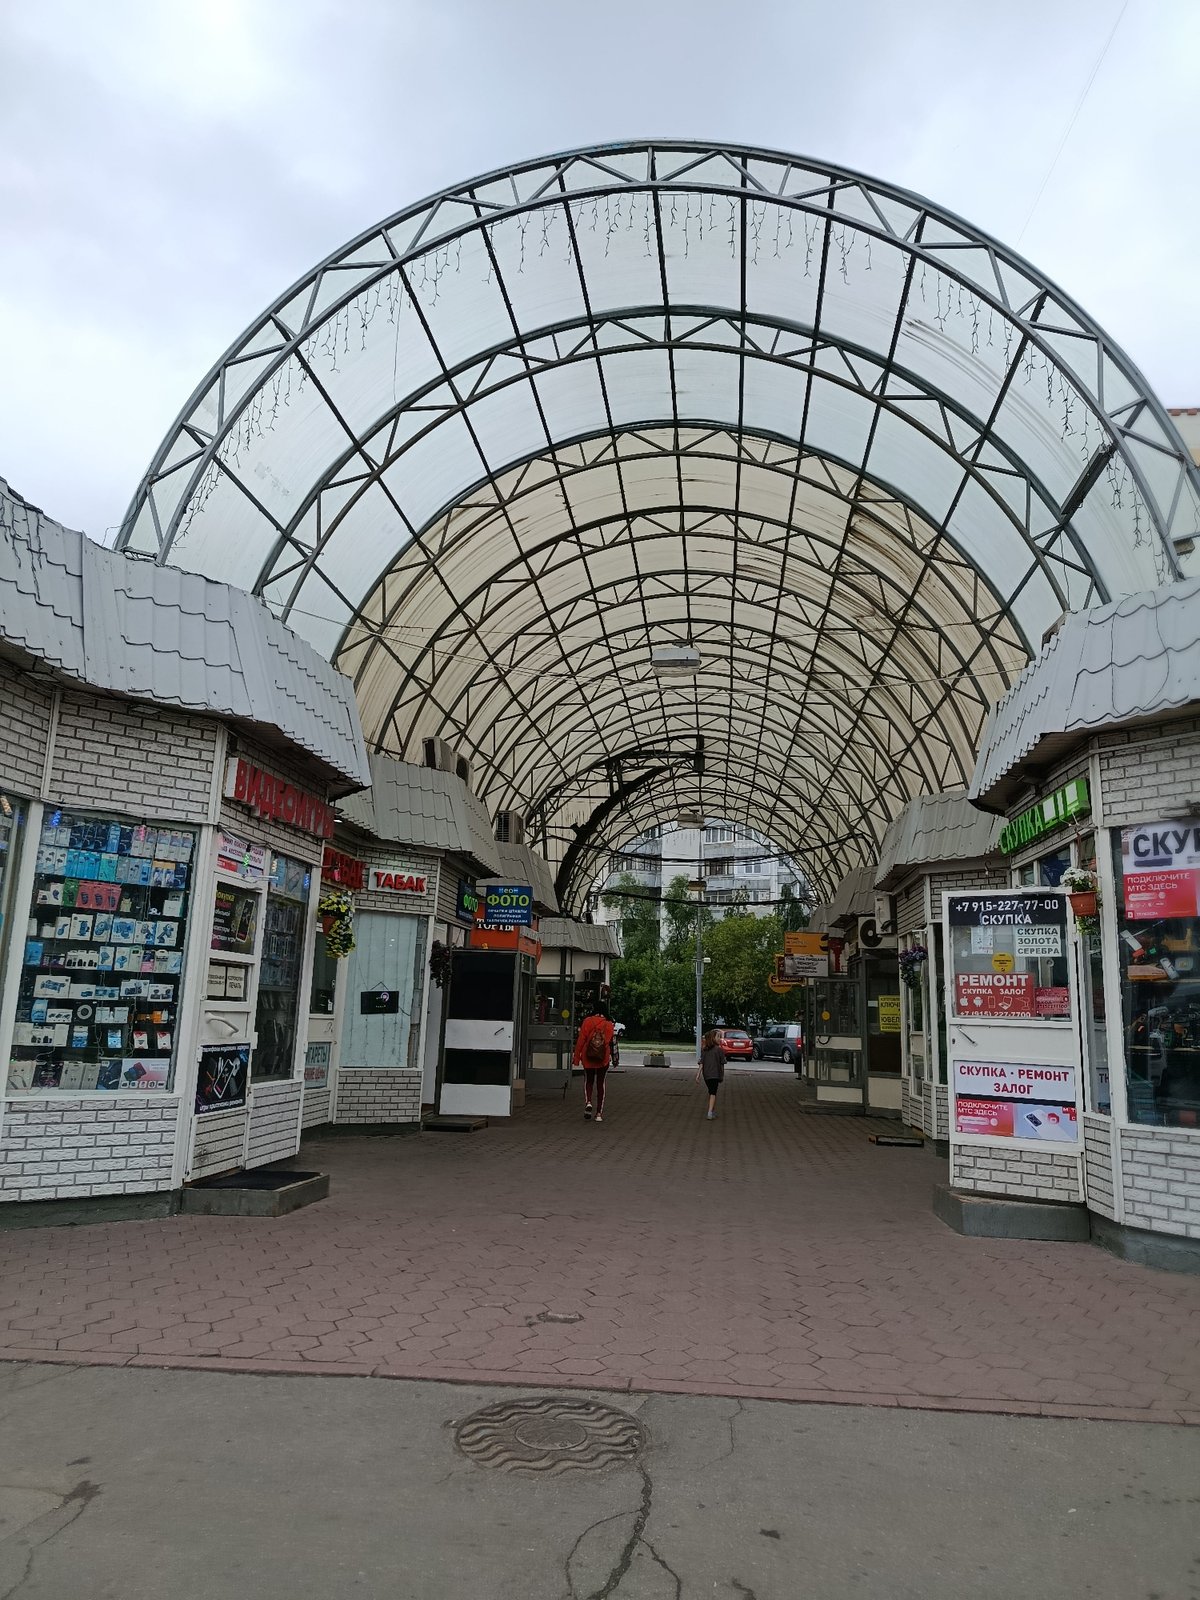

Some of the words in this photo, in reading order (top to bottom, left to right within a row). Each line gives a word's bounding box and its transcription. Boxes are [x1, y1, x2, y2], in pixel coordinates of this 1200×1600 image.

[234, 758, 335, 839] ВИДЕОИГРЫ
[1000, 804, 1044, 854] СКУПКА
[374, 871, 427, 893] ТАБАК
[1127, 872, 1190, 884] ПОДКЛЮЧИТЕ
[1127, 884, 1147, 892] МТС
[1147, 882, 1178, 891] ЗДЕСЬ
[463, 893, 479, 913] ФОТО
[486, 894, 530, 907] ФОТО
[955, 902, 970, 912] +7
[972, 899, 1059, 912] 915-227-77-00
[982, 914, 1033, 926] СКУПКА
[1017, 927, 1059, 936] СКУПКА
[1017, 937, 1059, 945] ЗОЛОТА
[1017, 947, 1060, 955] СЕРЕБРА
[959, 974, 1029, 987] РЕМОНТ
[959, 1065, 1007, 1078] СКУПКА
[1018, 1069, 1069, 1082] РЕМОНТ
[993, 1082, 1034, 1095] ЗАЛОГ
[957, 1101, 1008, 1111] ПОДКЛЮЧИТЕ
